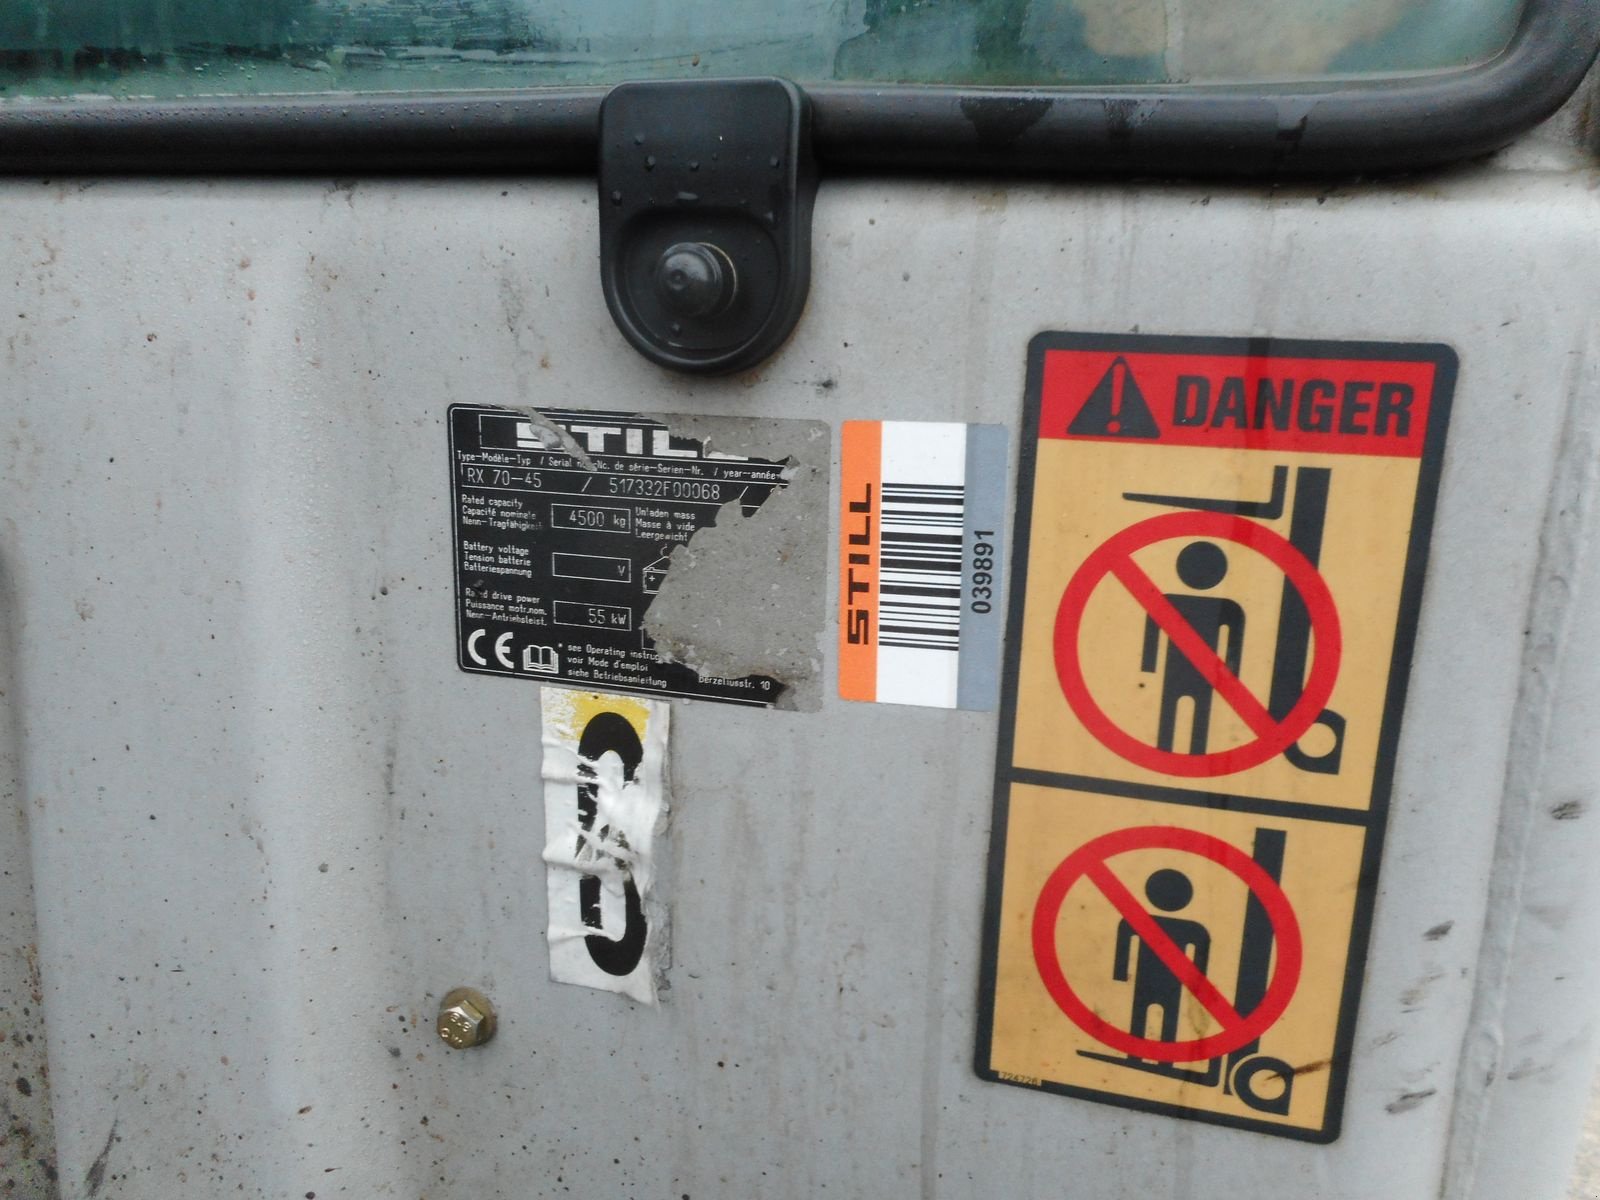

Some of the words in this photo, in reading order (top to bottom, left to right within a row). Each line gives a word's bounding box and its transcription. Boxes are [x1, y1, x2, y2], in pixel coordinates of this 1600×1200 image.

[1173, 375, 1415, 437] DANGER
[516, 422, 749, 461] STIL
[548, 456, 572, 467] Serial
[614, 461, 624, 471] de
[467, 467, 484, 484] RX
[492, 469, 542, 488] 70-45
[609, 477, 720, 500] 517332F00068
[461, 493, 485, 506] Rated
[488, 498, 523, 509] capacity
[462, 505, 497, 517] Capacité
[569, 510, 605, 527] 4500
[613, 514, 626, 528] kg
[635, 506, 669, 518] Unladen
[673, 512, 696, 520] mass
[635, 517, 662, 529] Masse
[666, 520, 672, 530] à
[675, 521, 696, 532] vide
[635, 528, 688, 542] Leergewicht
[463, 540, 494, 554] Battery
[497, 544, 529, 557] voltage
[463, 551, 495, 563] Tension
[498, 554, 532, 567] batterie
[848, 483, 872, 645] STILL
[463, 561, 532, 579] Batteriespannung
[971, 530, 994, 614] 039891
[465, 587, 489, 600] Rad
[491, 590, 513, 601] drive
[516, 595, 541, 604] power
[465, 598, 505, 611] Puissance
[588, 608, 606, 625] 55
[611, 612, 627, 625] kW
[467, 628, 515, 669] CE
[567, 644, 582, 653] see
[586, 643, 626, 659] Operating
[567, 656, 584, 665] voir
[588, 656, 609, 668] Mode
[613, 659, 649, 672] d'emploi
[567, 668, 589, 679] siehe
[593, 669, 668, 689] Betriebsanleitung
[760, 680, 771, 691] 10
